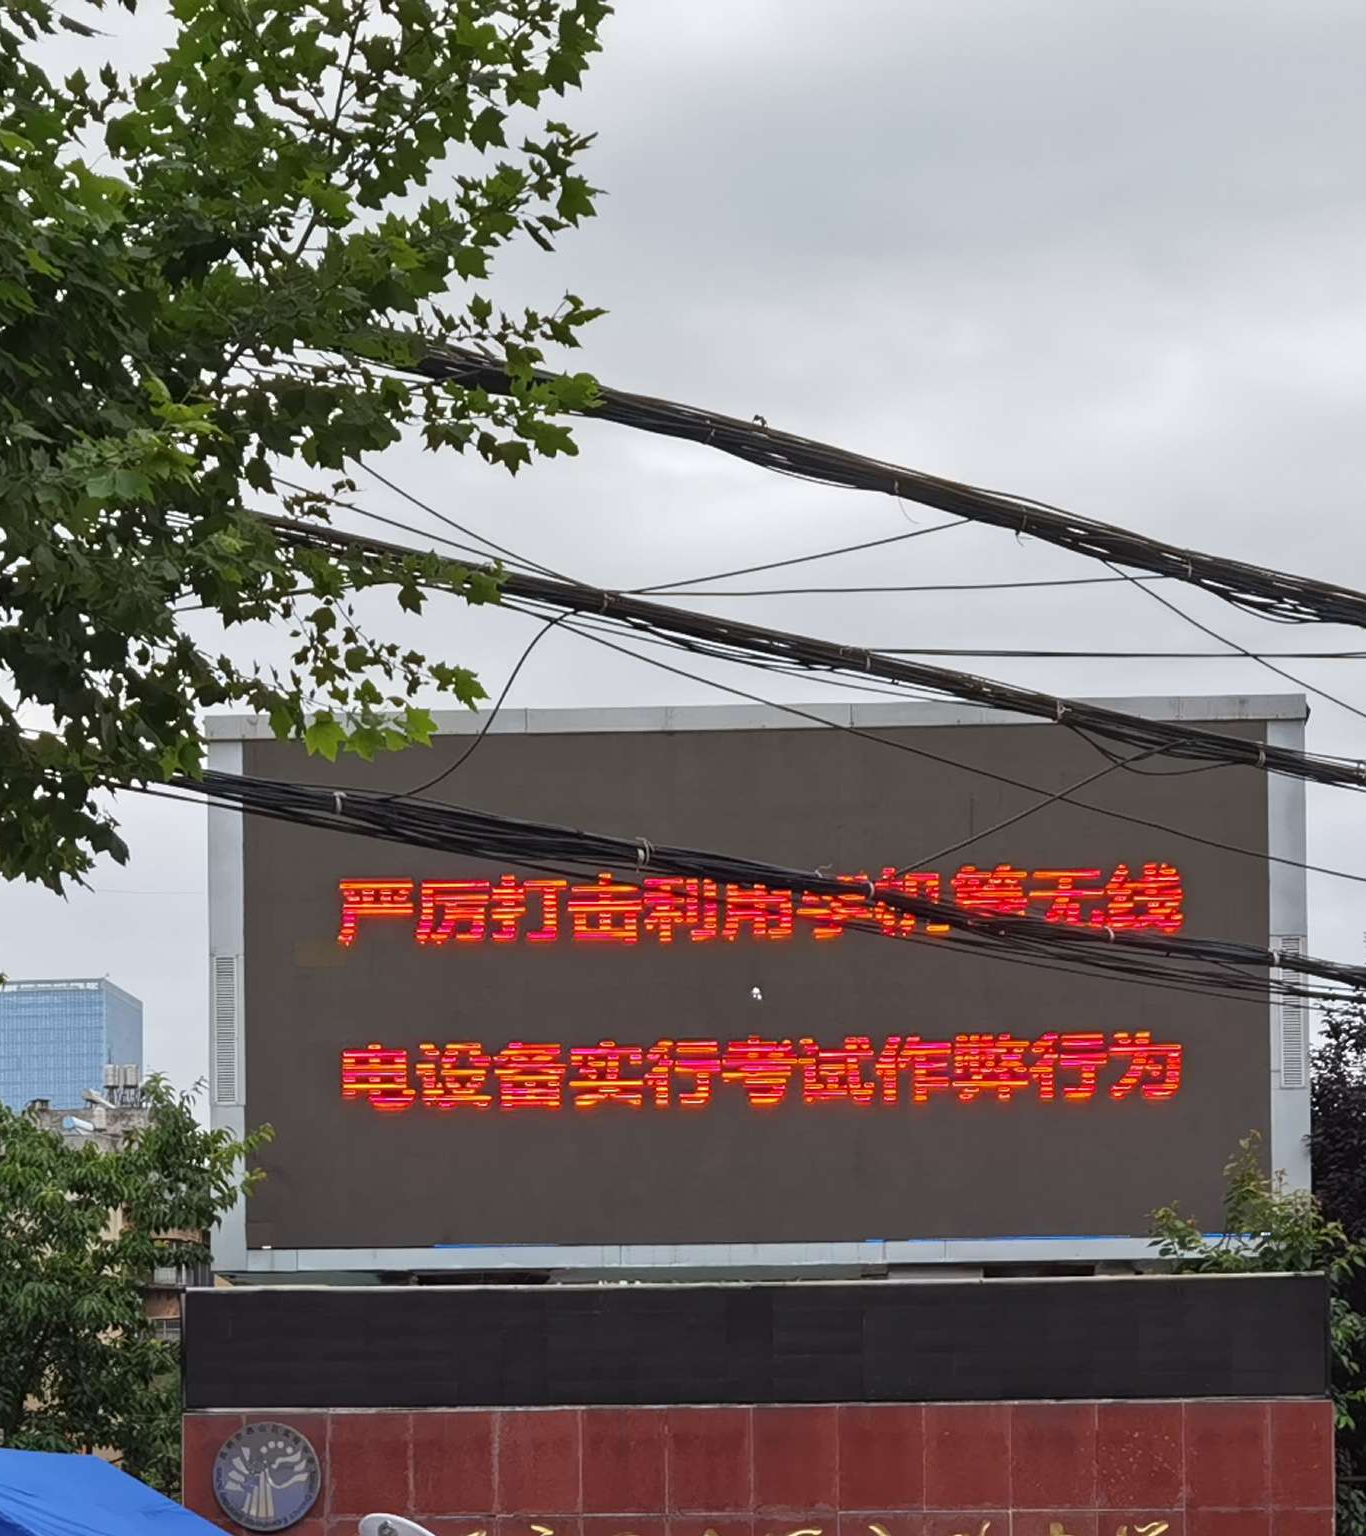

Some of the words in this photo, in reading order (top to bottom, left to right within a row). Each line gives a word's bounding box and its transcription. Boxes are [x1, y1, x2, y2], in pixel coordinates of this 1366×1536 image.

[341, 1030, 1182, 1112] 电设备实行考试作弊行为
